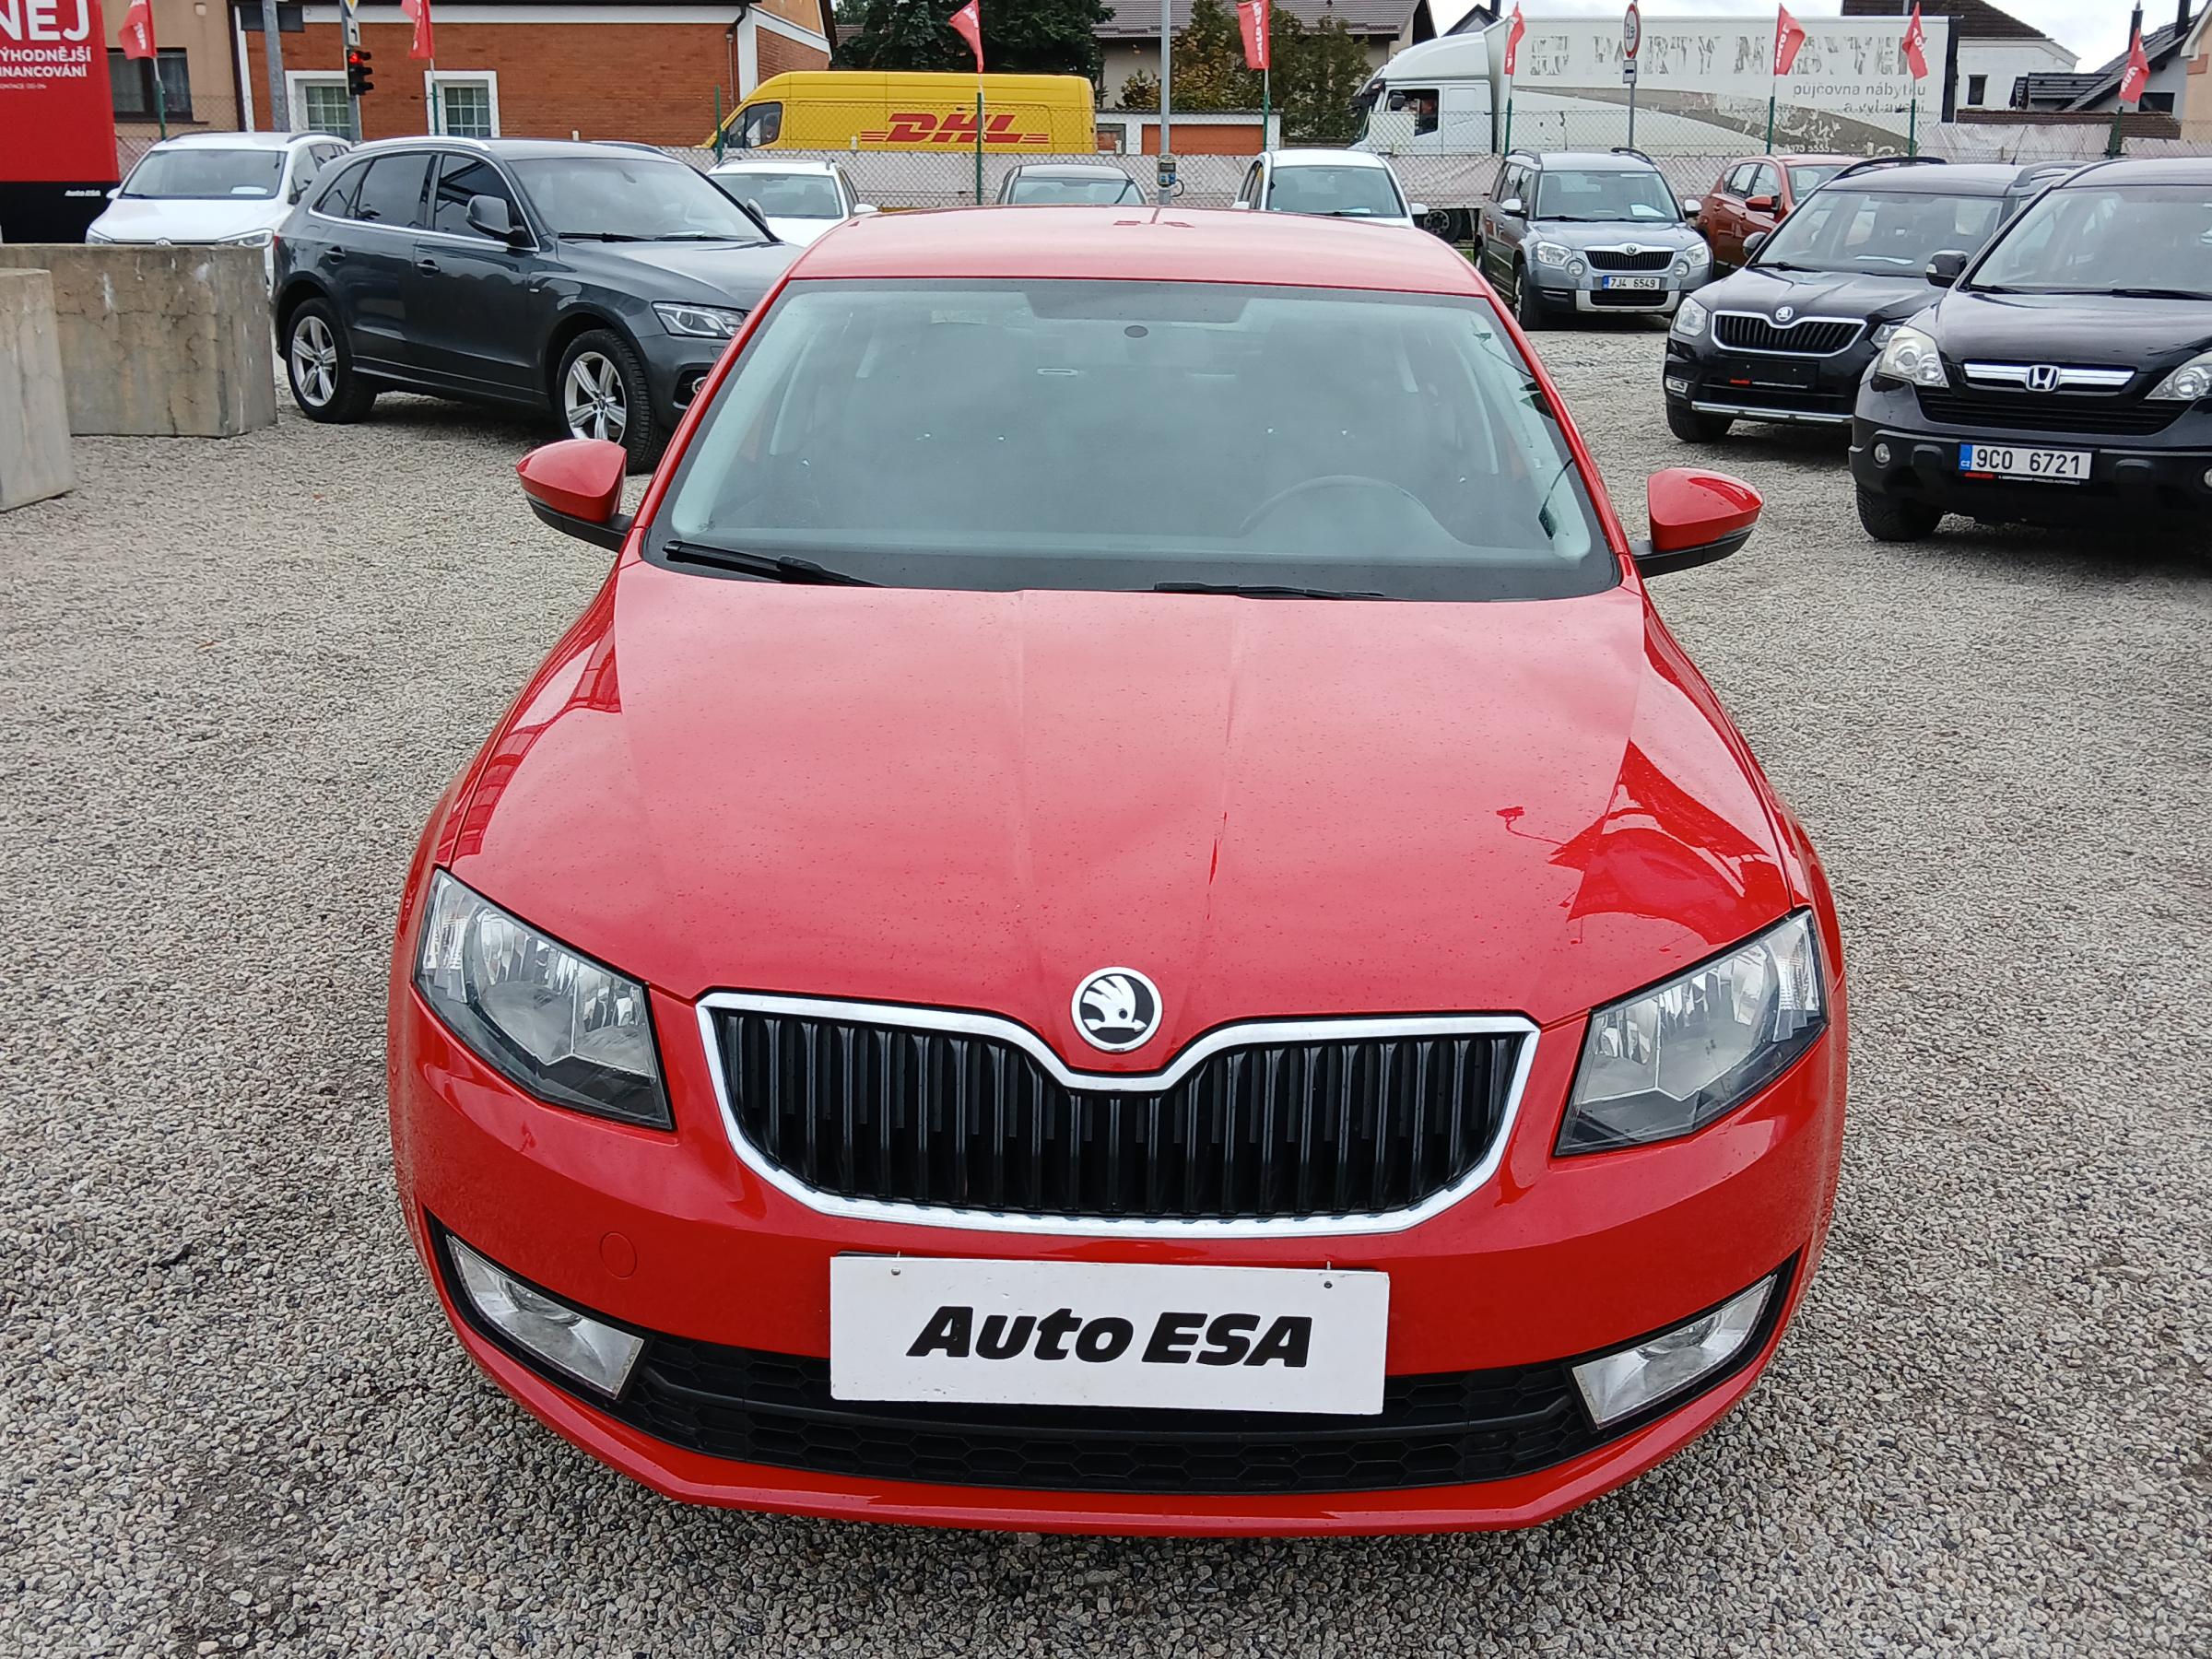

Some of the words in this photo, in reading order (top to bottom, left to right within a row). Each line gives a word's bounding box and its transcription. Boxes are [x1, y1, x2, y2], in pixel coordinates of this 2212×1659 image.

[885, 112, 1023, 143] DHL
[1976, 449, 2013, 470] 9C0
[2030, 453, 2080, 475] 6721
[906, 1305, 1134, 1363] Auto
[1141, 1312, 1312, 1368] ESA
